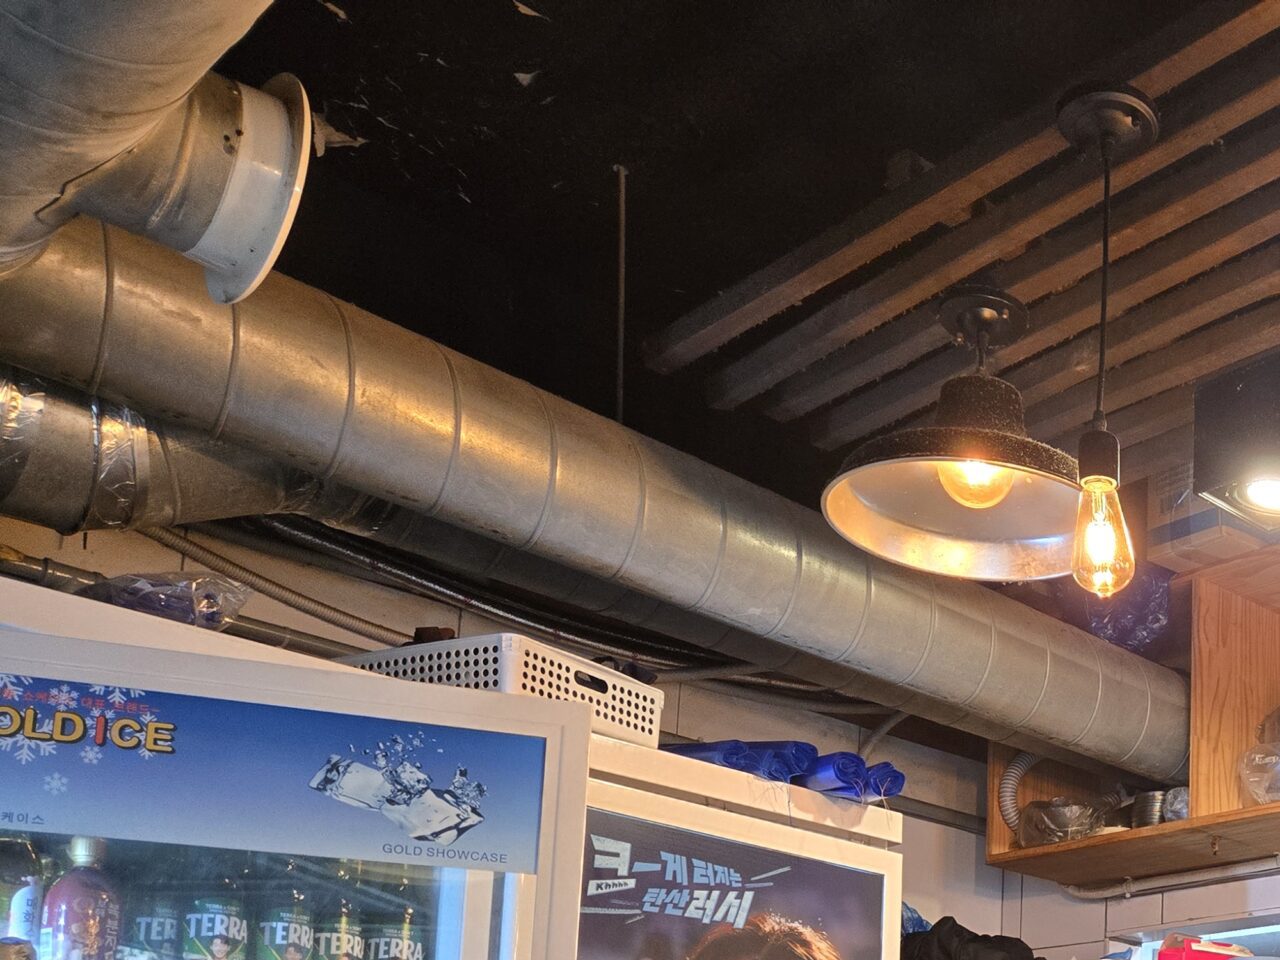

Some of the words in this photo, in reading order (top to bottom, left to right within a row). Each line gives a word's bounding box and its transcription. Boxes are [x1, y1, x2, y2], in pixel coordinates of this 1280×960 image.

[382, 843, 423, 857] GOLD
[426, 847, 508, 863] SHOWCASE
[136, 917, 178, 941] TER
[186, 913, 248, 943] TERRA
[315, 932, 365, 959] TERR
